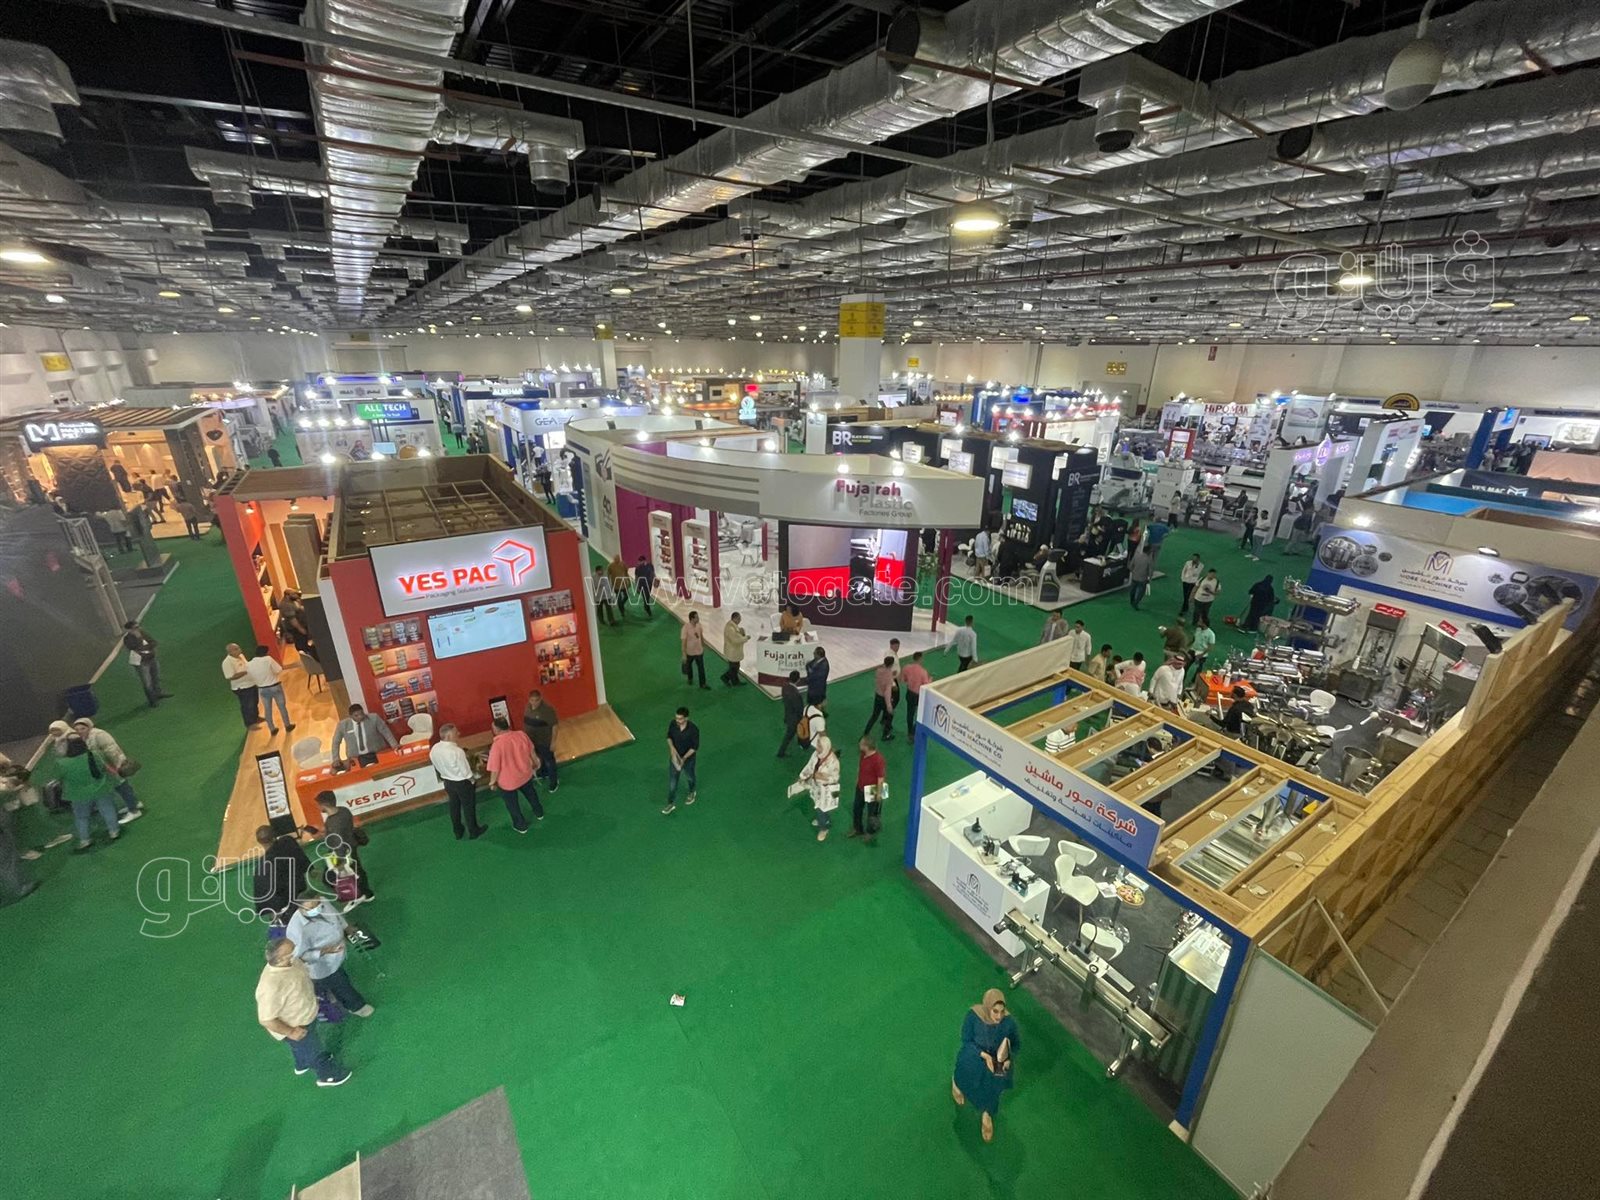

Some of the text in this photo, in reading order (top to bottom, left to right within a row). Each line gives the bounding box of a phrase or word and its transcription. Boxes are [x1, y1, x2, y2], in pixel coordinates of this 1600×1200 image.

[364, 403, 406, 412] ALL TECH
[534, 417, 559, 427] GEA
[832, 430, 853, 446] BR
[1067, 471, 1081, 487] BR
[398, 563, 499, 595] YES PAC
[966, 733, 992, 753] MACHINE
[346, 795, 371, 808] YES
[372, 787, 397, 801] PAC
[1025, 761, 1137, 836] شركة مور ماشين
